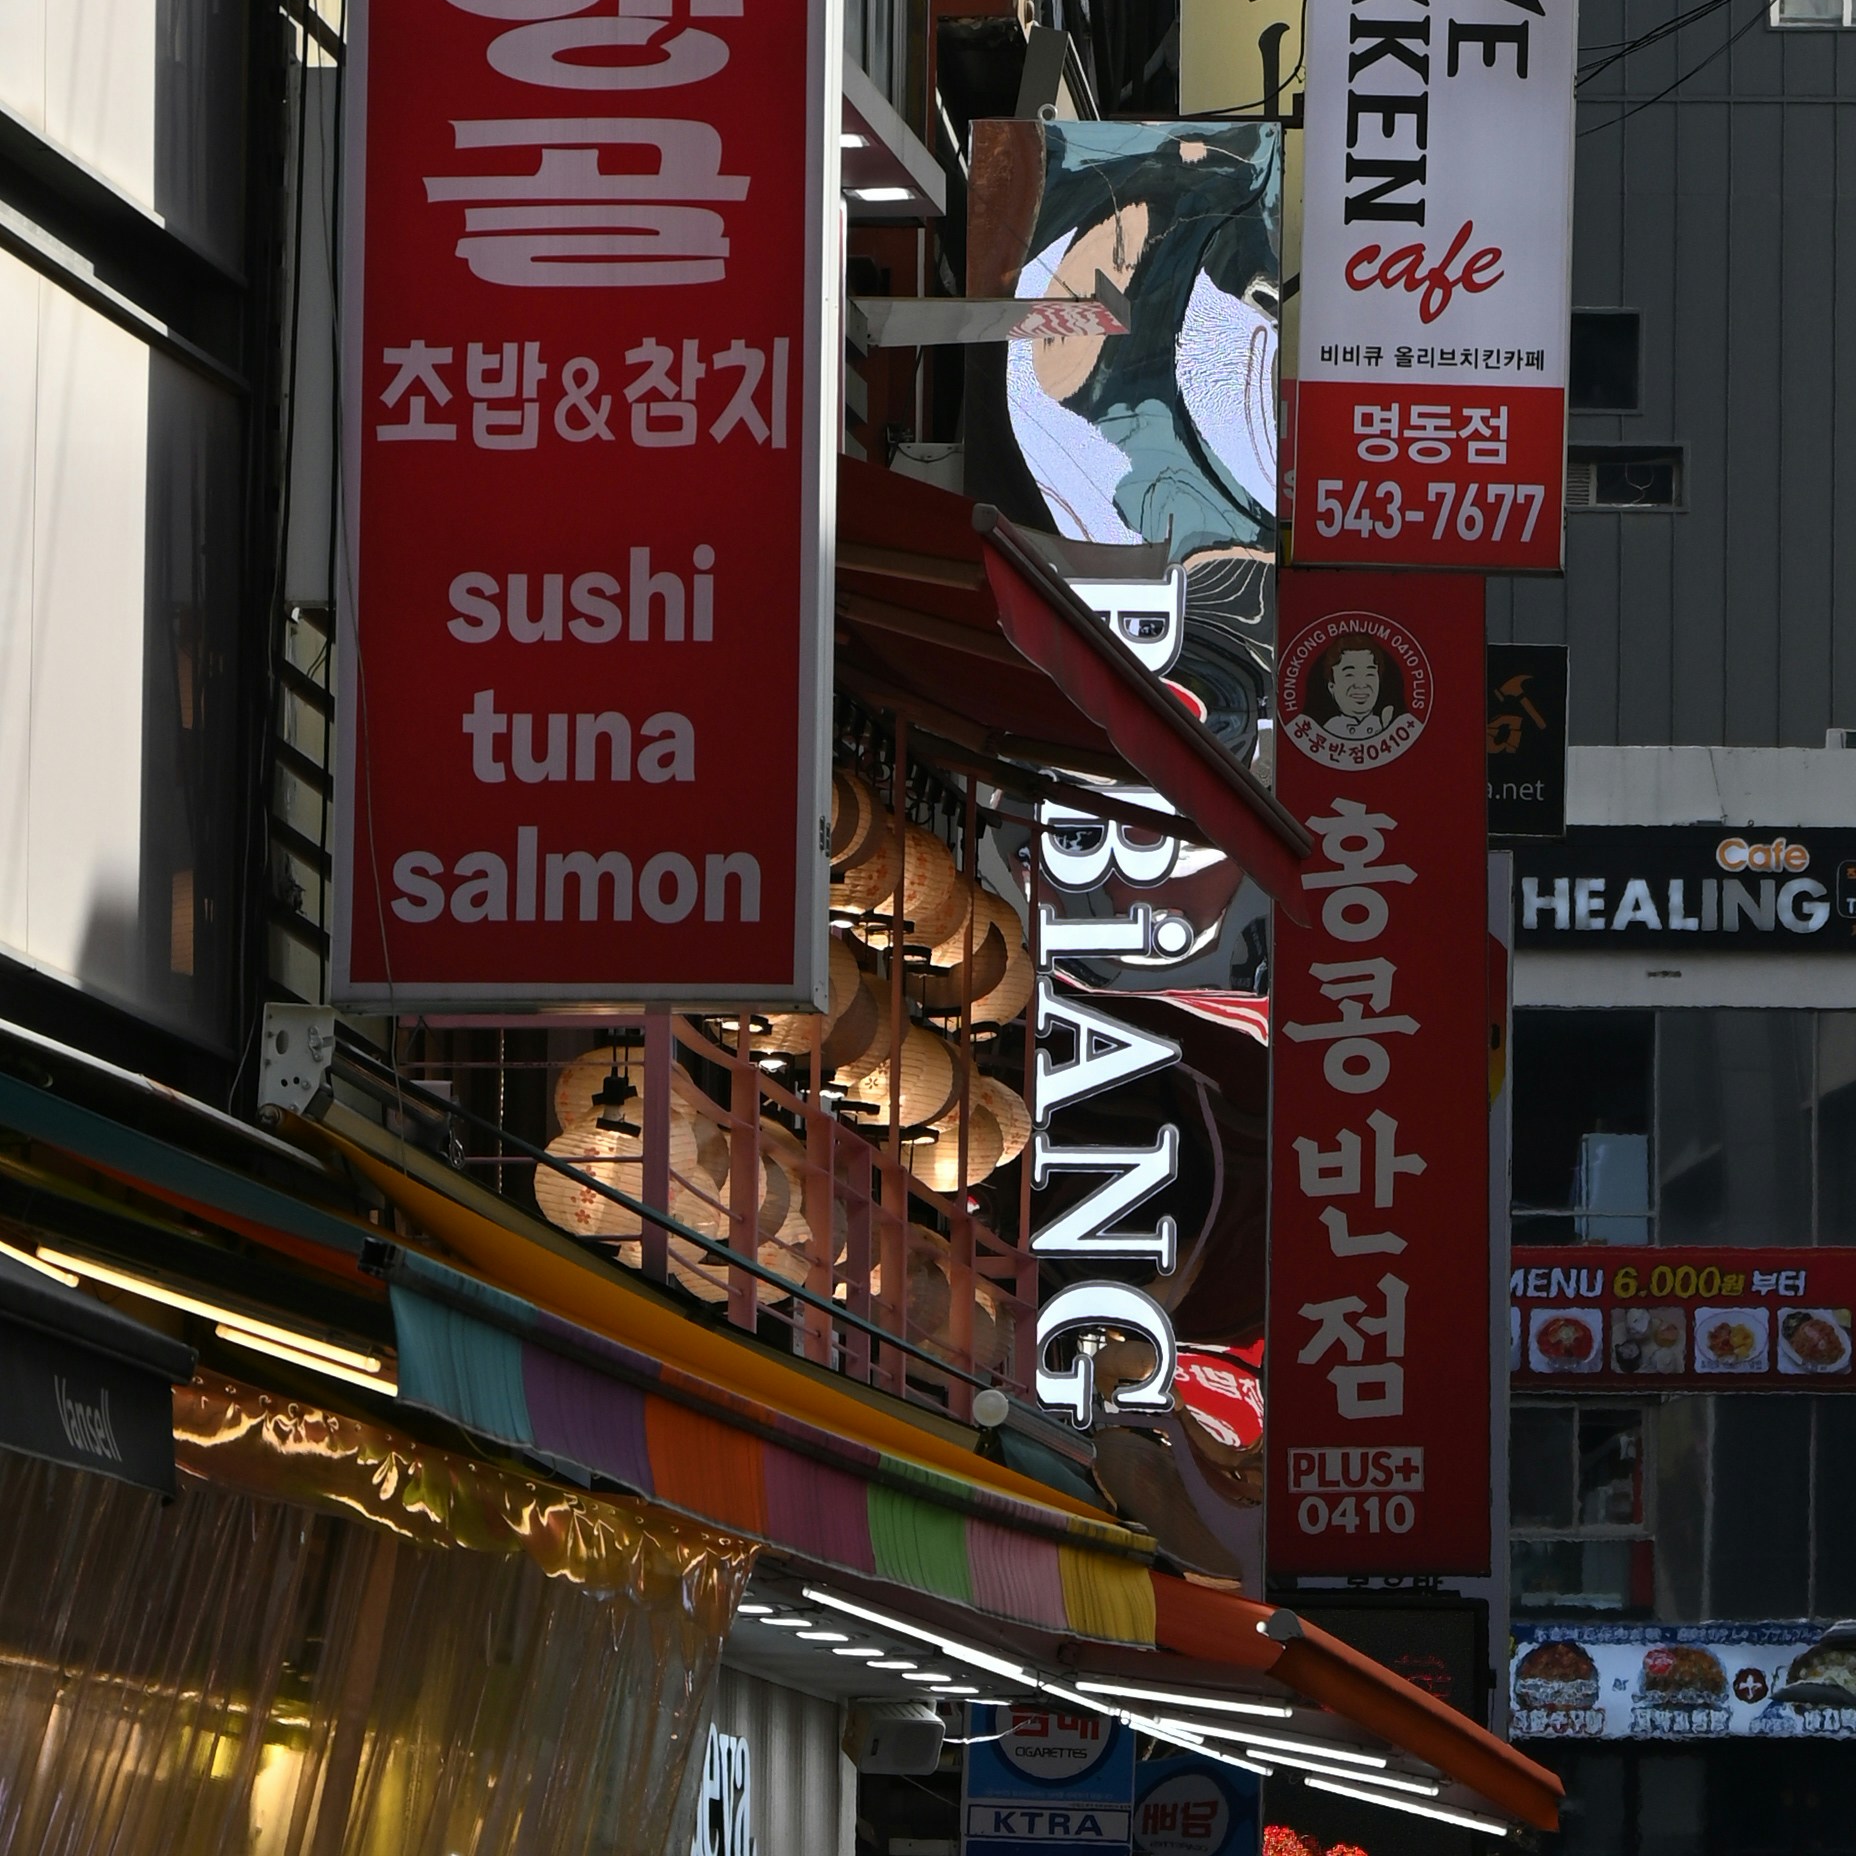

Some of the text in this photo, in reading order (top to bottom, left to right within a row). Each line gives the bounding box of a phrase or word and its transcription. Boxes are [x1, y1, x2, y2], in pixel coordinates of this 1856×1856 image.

[1344, 220, 1505, 324] cafe
[1320, 343, 1546, 374] 비비큐 올리브치킨카페
[376, 336, 790, 451] 초밥&참치
[1352, 402, 1511, 468] 명동점
[1314, 479, 1545, 543] 543-7677
[446, 544, 715, 643] sushi
[1283, 619, 1426, 712] HONGKONG BANJUM 0410 PLUS
[462, 689, 696, 784] tuna
[390, 826, 762, 924] salmon
[1716, 837, 1810, 873] Cafe
[1521, 877, 1830, 933] HEALING
[1282, 795, 1428, 1420] 홍콩반점
[1751, 1269, 1807, 1298] 부터
[1297, 1496, 1416, 1536] 0410
[993, 1810, 1104, 1837] KTRA
